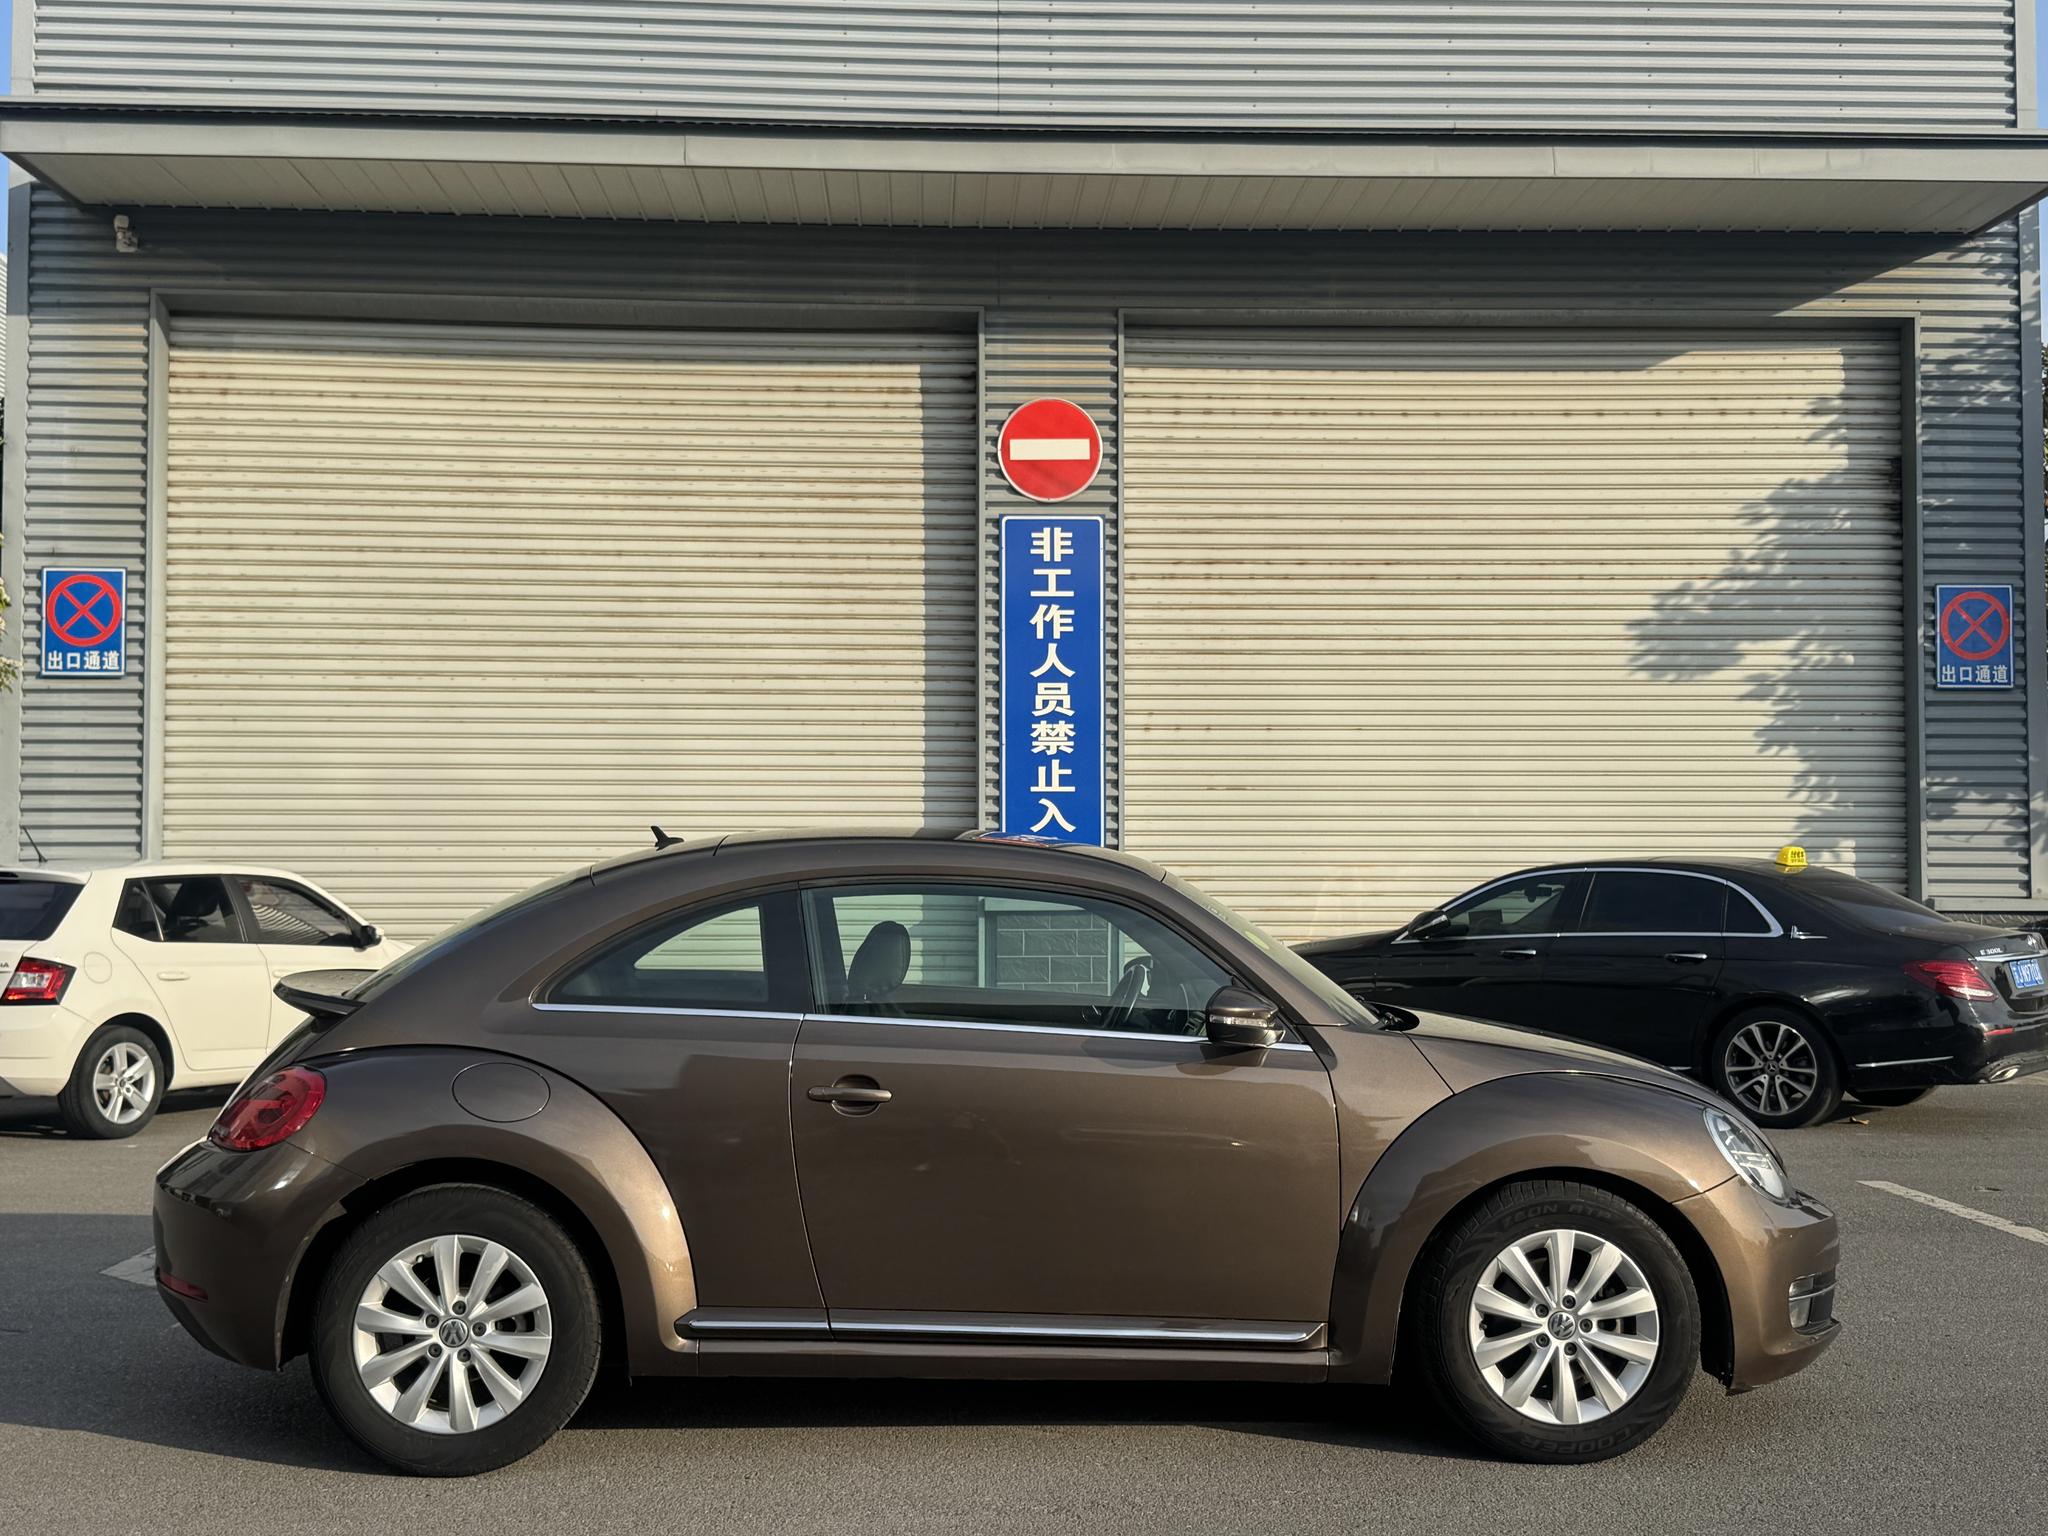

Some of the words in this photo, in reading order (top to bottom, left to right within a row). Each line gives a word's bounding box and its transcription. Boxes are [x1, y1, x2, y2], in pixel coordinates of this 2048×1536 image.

[47, 650, 120, 670] 出口通道
[1030, 527, 1076, 833] 非工作人员禁止入
[1941, 664, 2008, 683] 出口通道
